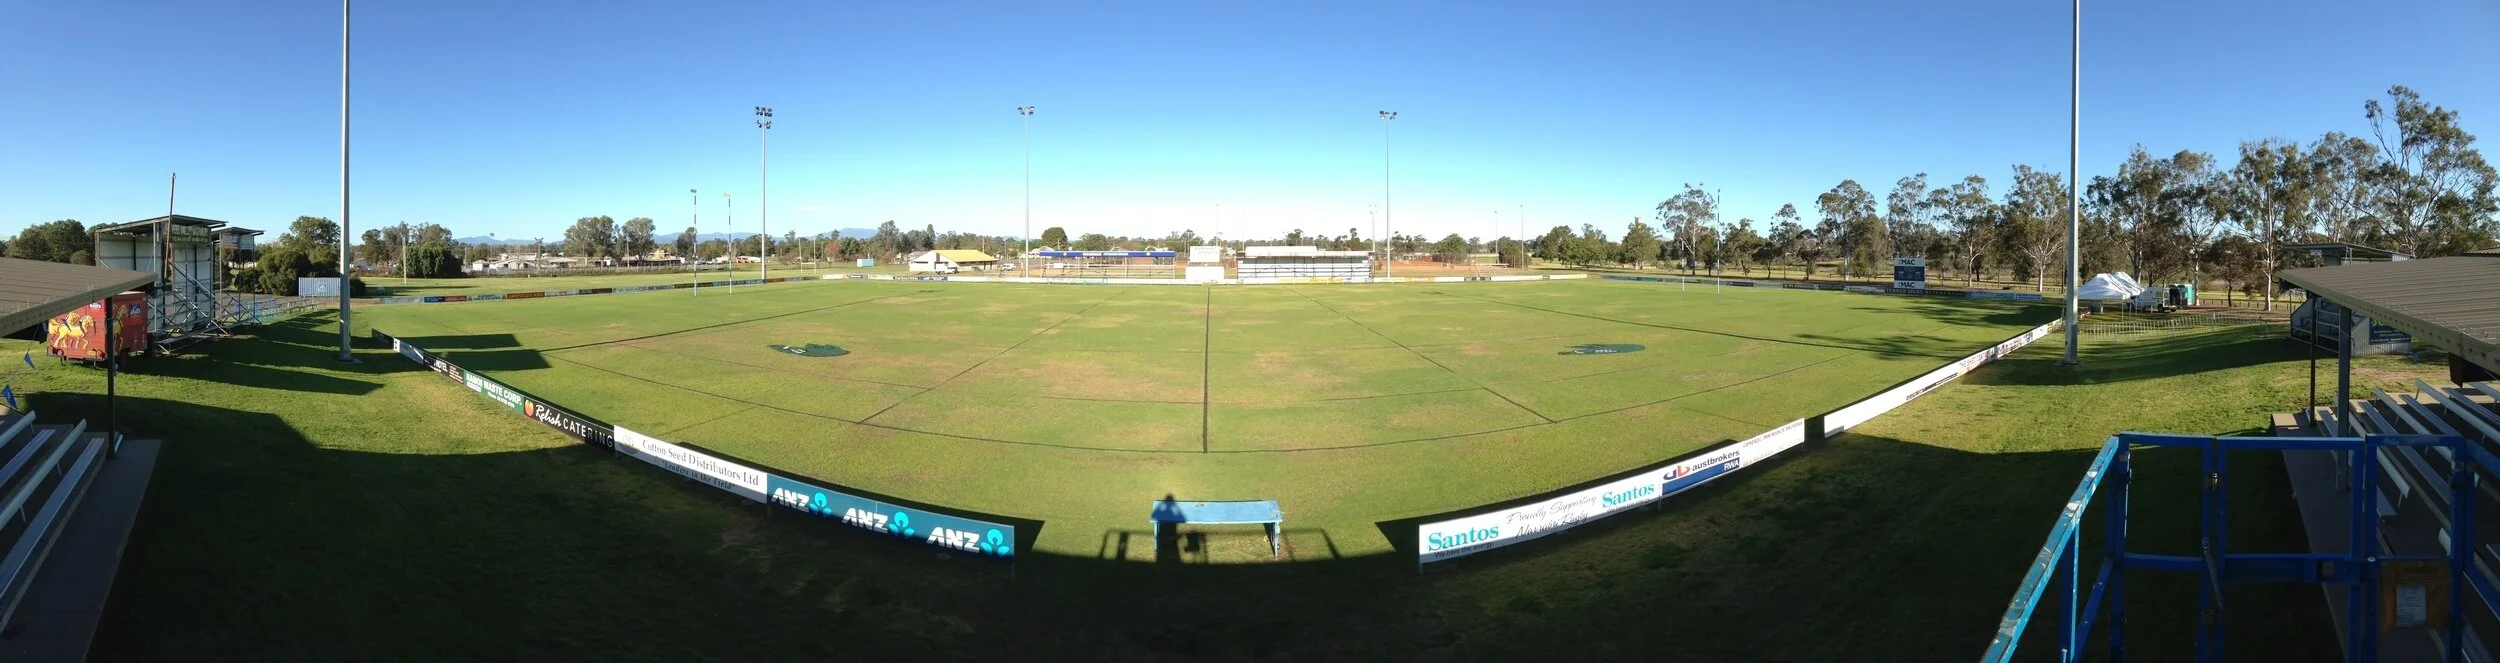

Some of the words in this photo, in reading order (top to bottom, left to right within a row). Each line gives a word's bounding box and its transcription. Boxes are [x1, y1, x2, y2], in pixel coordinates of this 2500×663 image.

[484, 381, 503, 396] WASTE
[535, 404, 561, 427] Relish
[563, 418, 613, 447] CATERING
[642, 439, 666, 456] Cotton
[668, 447, 687, 462] Seed
[689, 454, 740, 480] Distributors
[743, 472, 759, 486] Ltd
[1692, 450, 1740, 472] austbrokers
[1723, 459, 1739, 471] RWA
[771, 487, 809, 512] ANZ
[1602, 483, 1655, 508] Santos
[841, 507, 888, 533] ANZ
[1506, 506, 1547, 525] Proudly
[1550, 495, 1597, 515] Supporting
[1560, 511, 1589, 528] Rugby
[926, 526, 980, 553] ANZ
[1428, 524, 1499, 552] Santos
[1434, 550, 1447, 558] We
[1448, 548, 1460, 557] have
[1461, 545, 1472, 553] the
